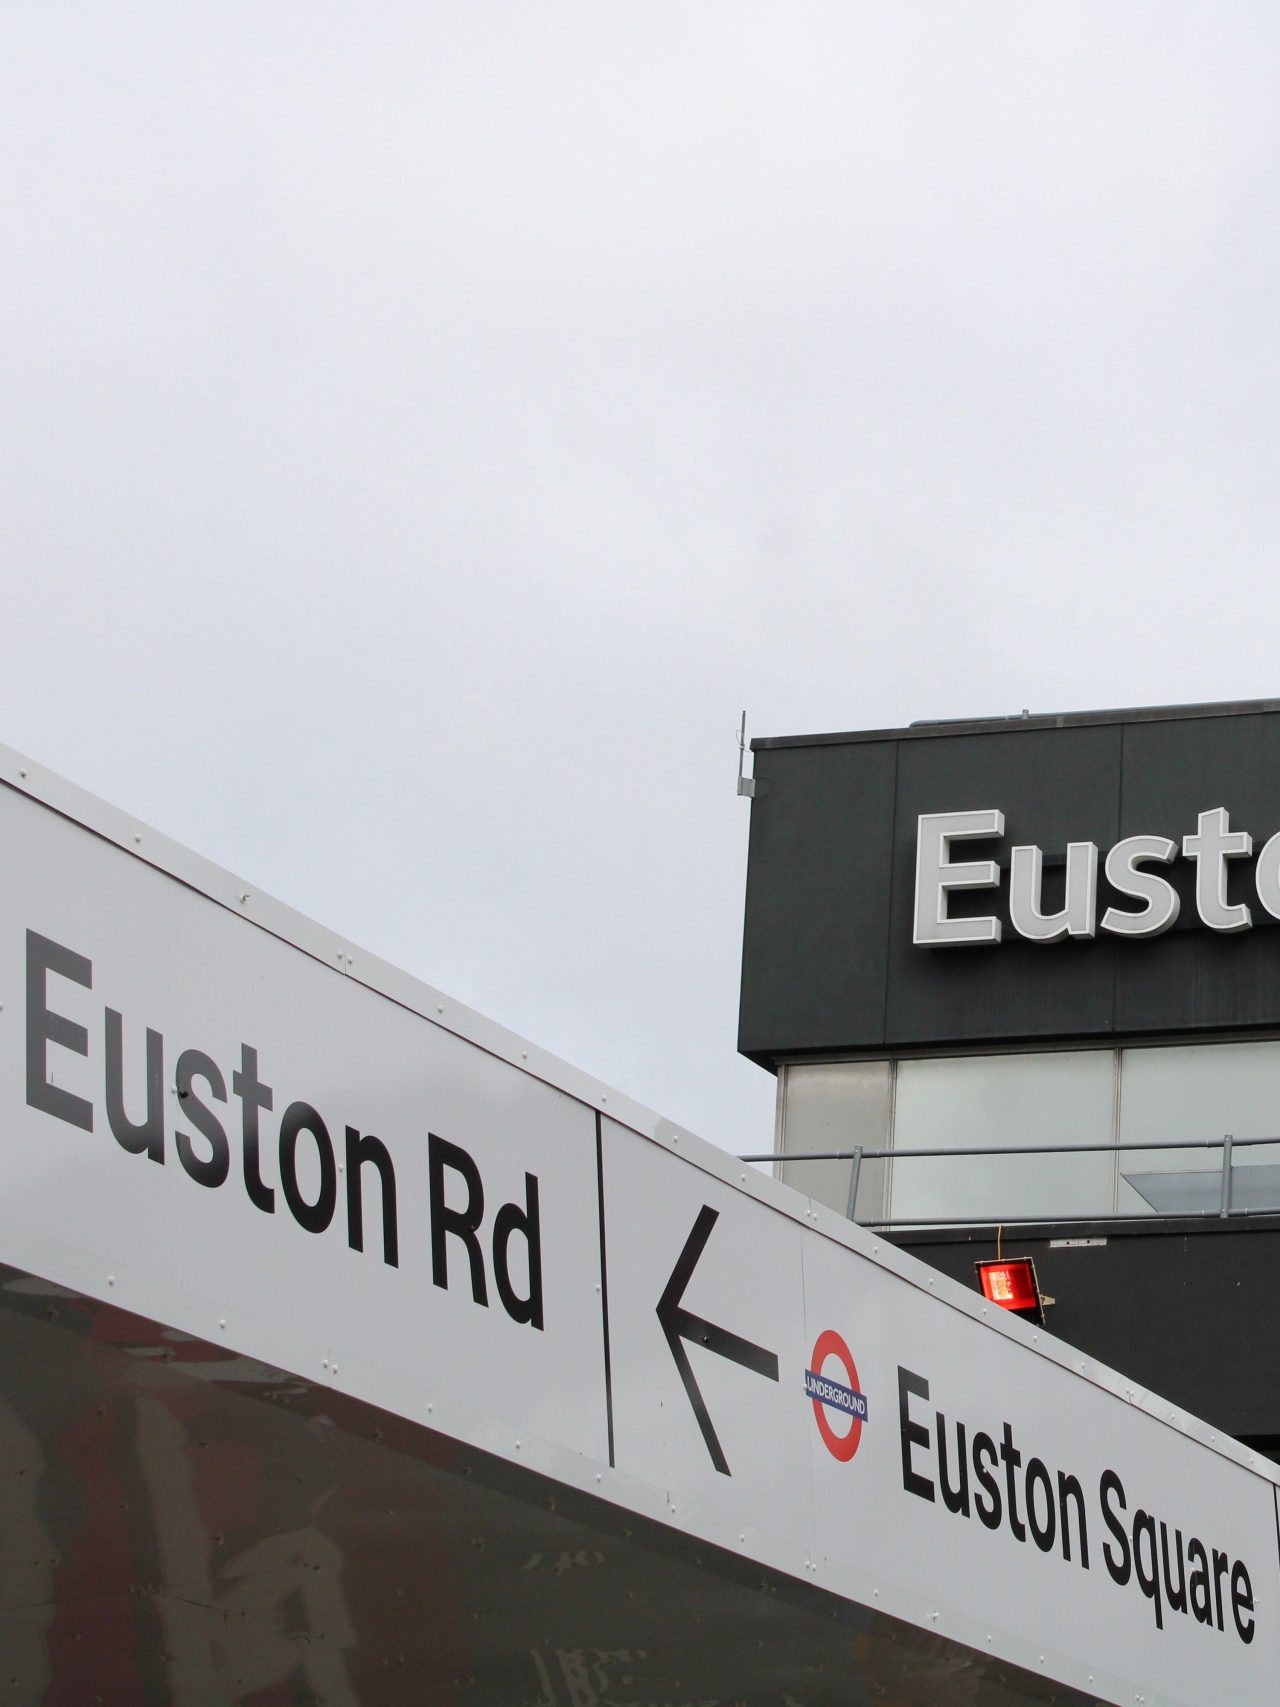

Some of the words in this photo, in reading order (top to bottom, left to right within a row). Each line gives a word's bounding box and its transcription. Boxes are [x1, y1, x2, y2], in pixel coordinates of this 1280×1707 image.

[26, 927, 399, 1270] Euston
[428, 1131, 544, 1332] Rd
[806, 1375, 866, 1415] UNDERGROUND
[897, 1365, 1090, 1570] Euston
[1100, 1469, 1256, 1646] Square
